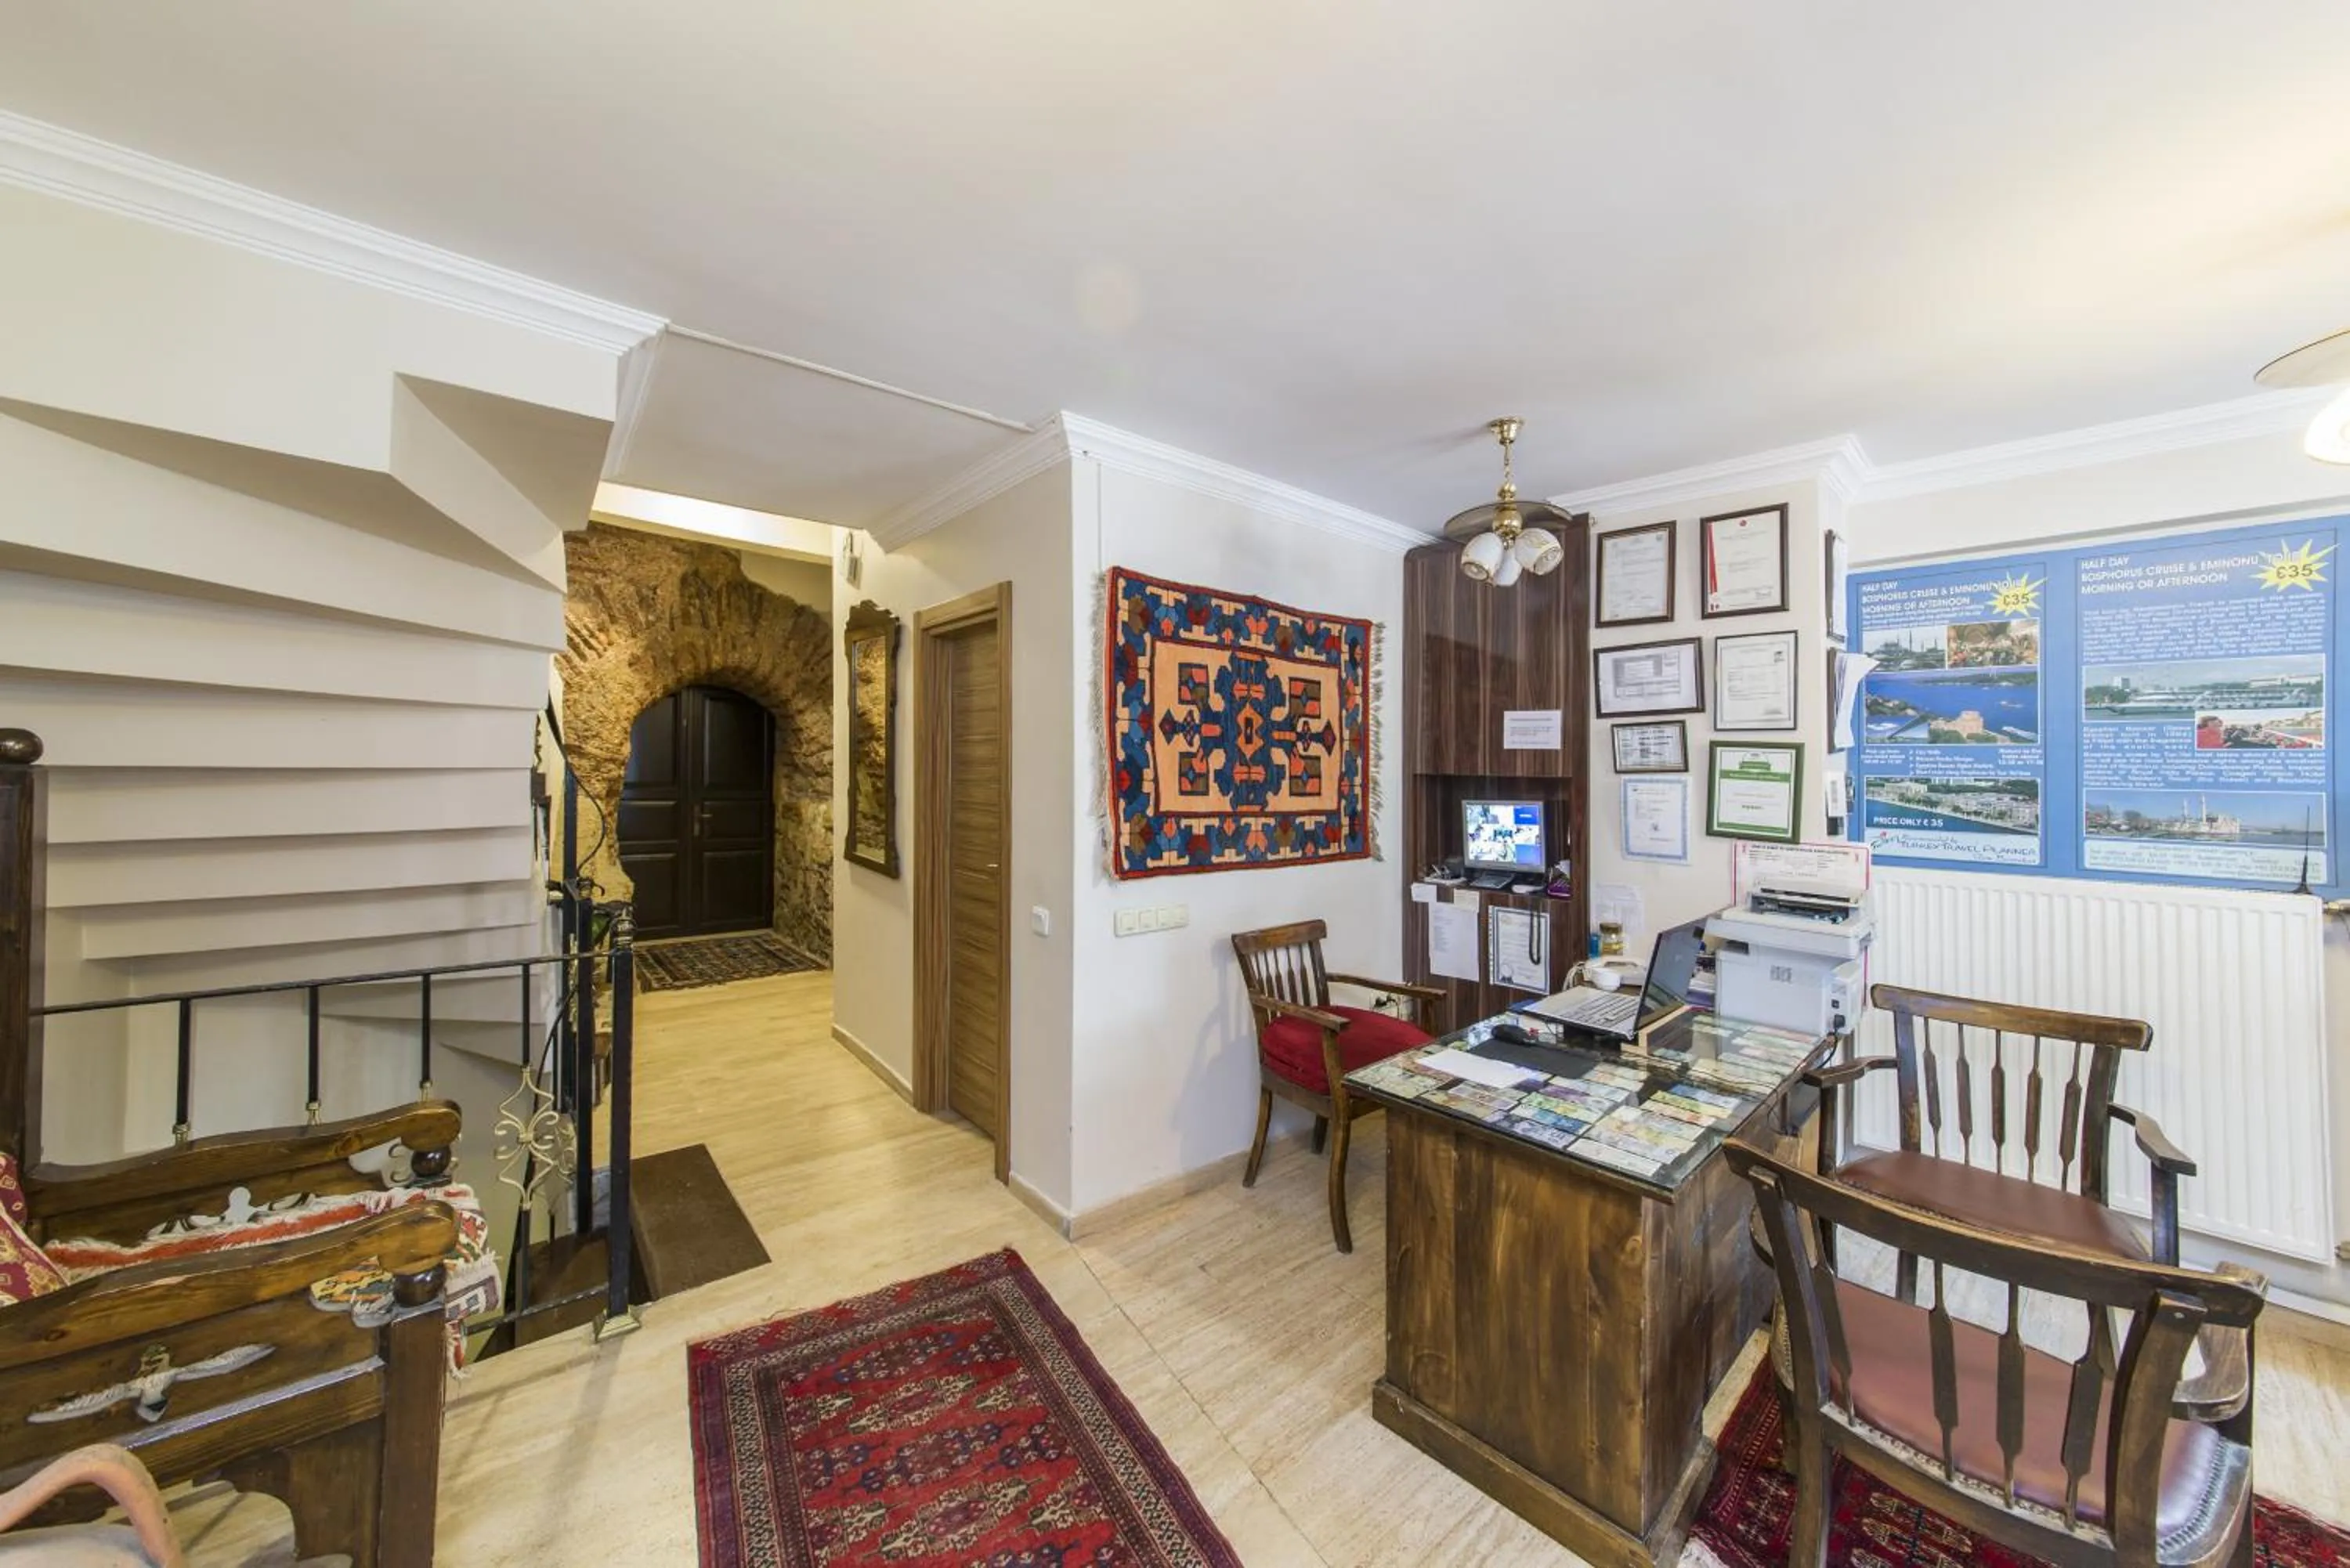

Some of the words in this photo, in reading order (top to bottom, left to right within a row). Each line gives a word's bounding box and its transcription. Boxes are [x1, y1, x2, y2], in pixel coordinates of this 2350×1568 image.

[2081, 559, 2106, 570] HALF
[2109, 556, 2129, 567] DAY
[2146, 562, 2185, 576] CRUISE
[1882, 580, 1898, 590] DAY
[2081, 581, 2134, 594] MORNING
[2137, 579, 2153, 590] OR
[2157, 573, 2228, 587] AFTERNOON
[1904, 602, 1916, 610] OR
[1873, 816, 1898, 826] PRICE
[1900, 818, 1922, 827] ONLY
[1930, 818, 1943, 828] 35
